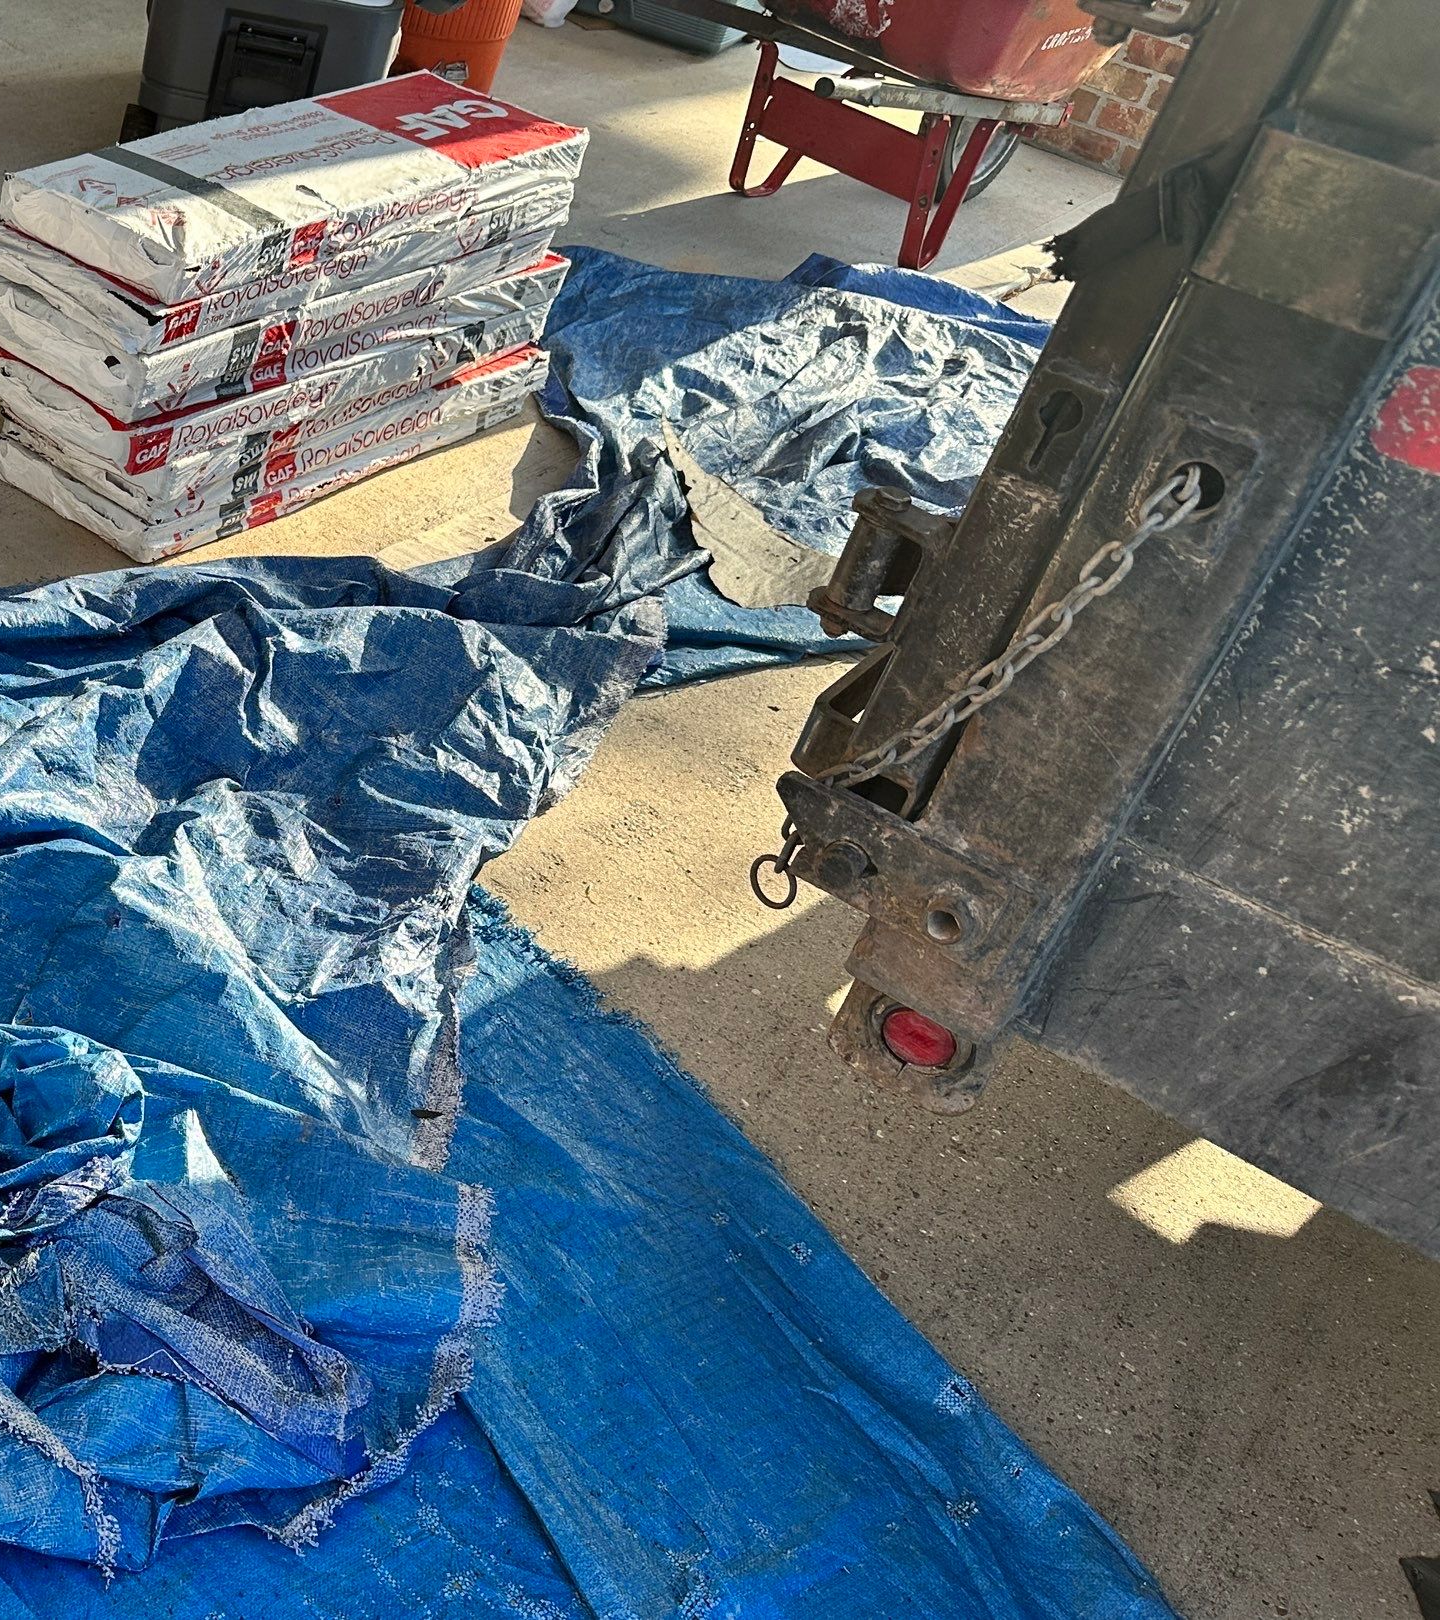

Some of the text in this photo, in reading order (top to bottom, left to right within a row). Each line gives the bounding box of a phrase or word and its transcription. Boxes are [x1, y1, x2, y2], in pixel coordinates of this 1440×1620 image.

[395, 100, 510, 141] GAF
[490, 209, 512, 230] SW
[168, 254, 368, 331] GAF RoyalSovereign
[231, 342, 257, 363] SW
[301, 280, 445, 342] RoyalSovereign
[252, 363, 283, 382] GAF
[136, 441, 168, 465] GAF
[176, 380, 339, 450] RoyalSovereign
[235, 404, 443, 492] SW GAF RoyalSovereign
